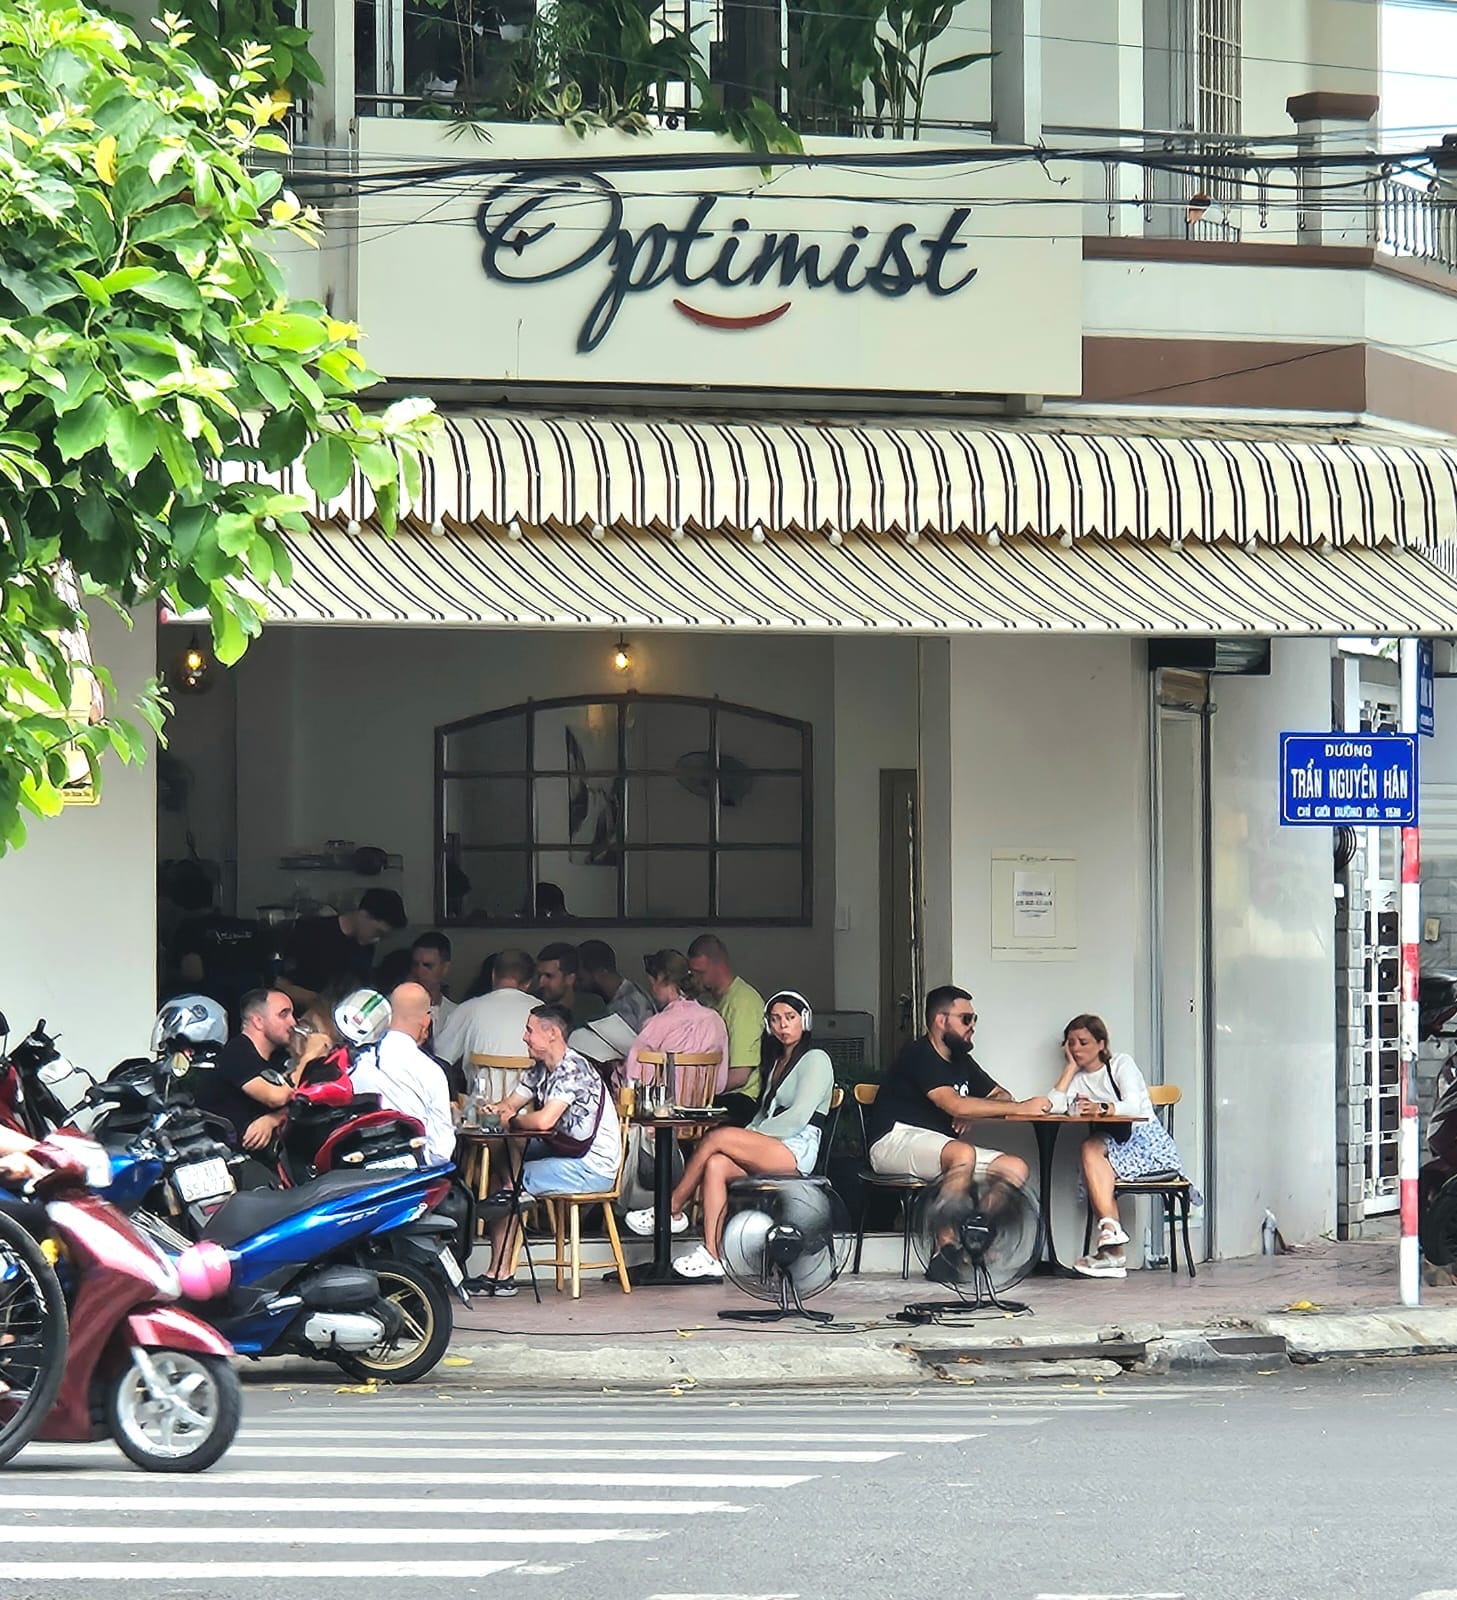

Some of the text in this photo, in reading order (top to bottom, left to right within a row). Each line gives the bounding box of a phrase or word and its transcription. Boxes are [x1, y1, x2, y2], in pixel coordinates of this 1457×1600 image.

[476, 171, 978, 354] Optimist
[1325, 741, 1373, 757] ĐƯỜNG
[1329, 762, 1378, 799] NGUYÊN
